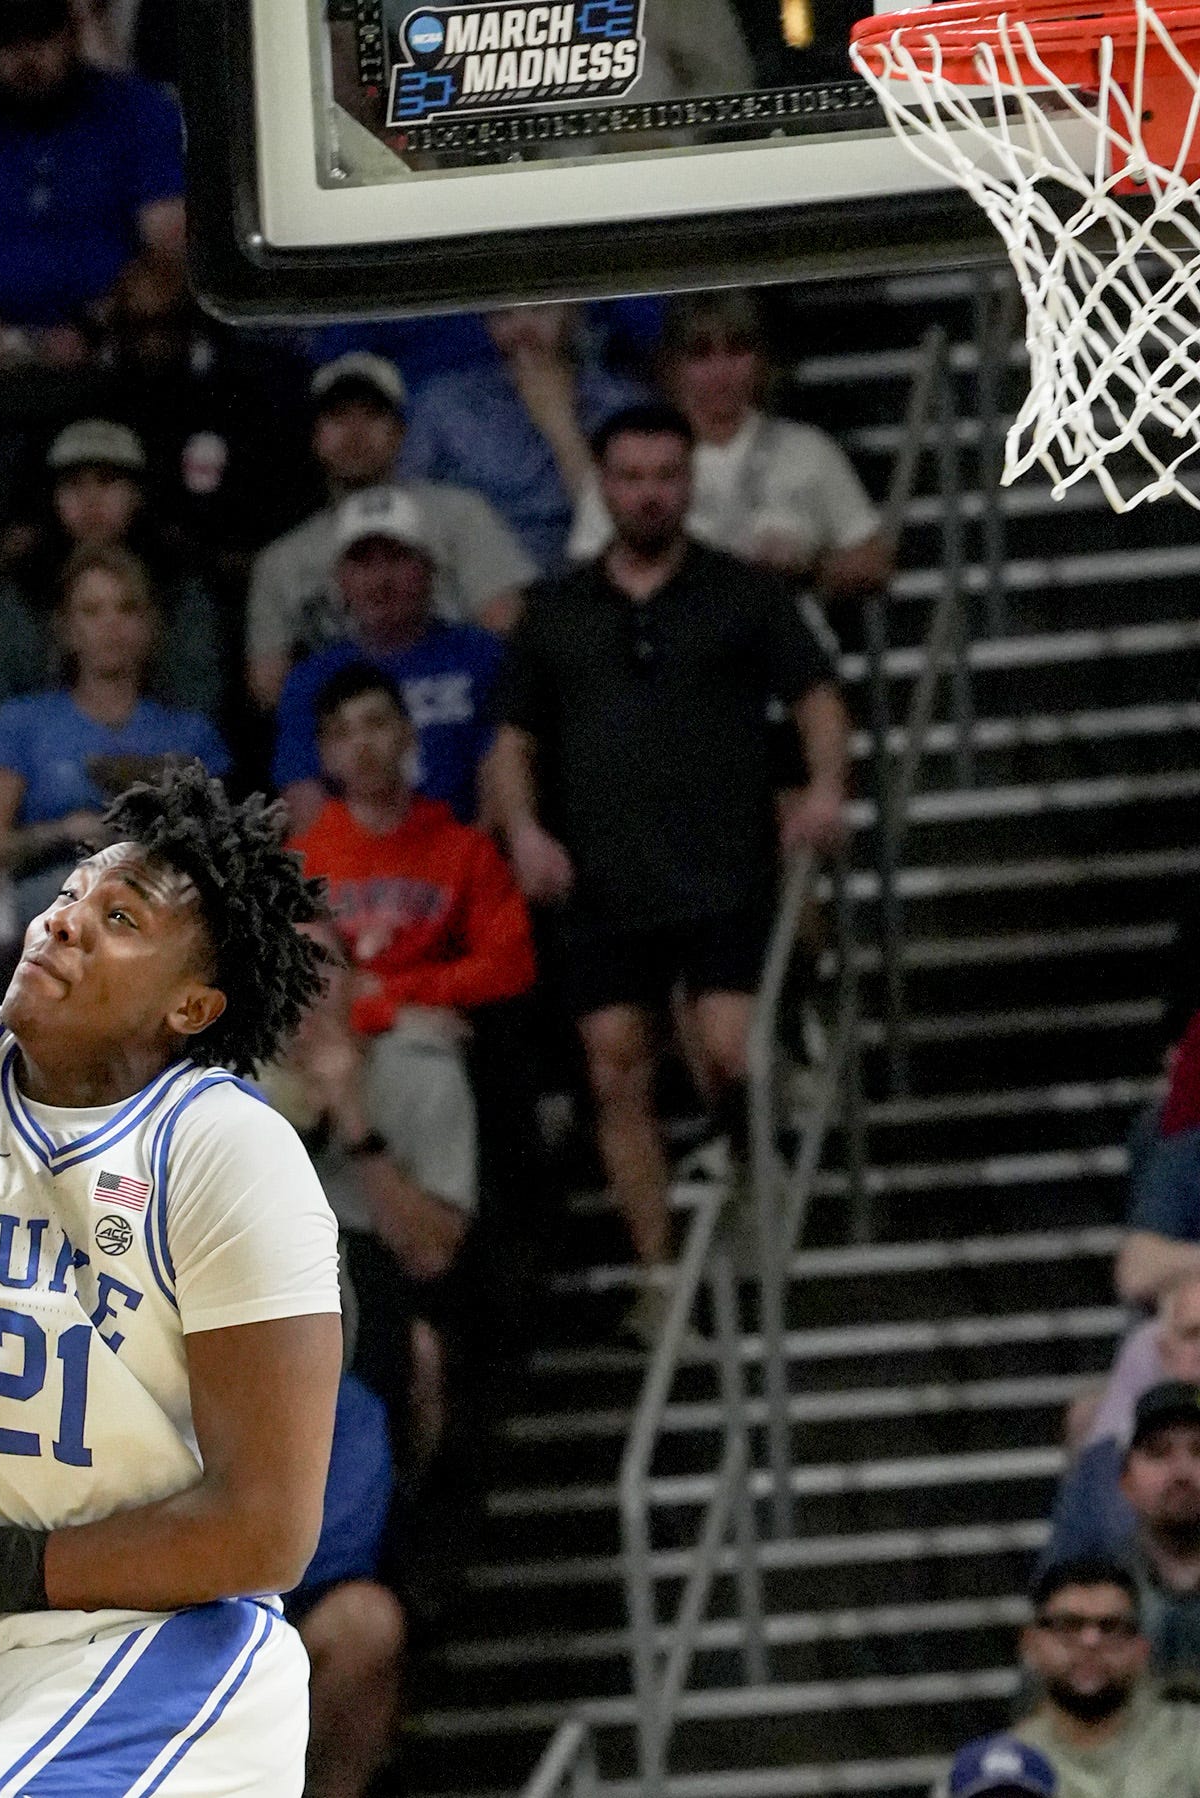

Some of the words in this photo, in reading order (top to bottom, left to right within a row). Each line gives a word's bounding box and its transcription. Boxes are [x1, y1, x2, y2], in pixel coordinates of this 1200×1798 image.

[443, 4, 575, 55] MARCH
[461, 39, 638, 95] MADNESS
[99, 1227, 132, 1244] ACC
